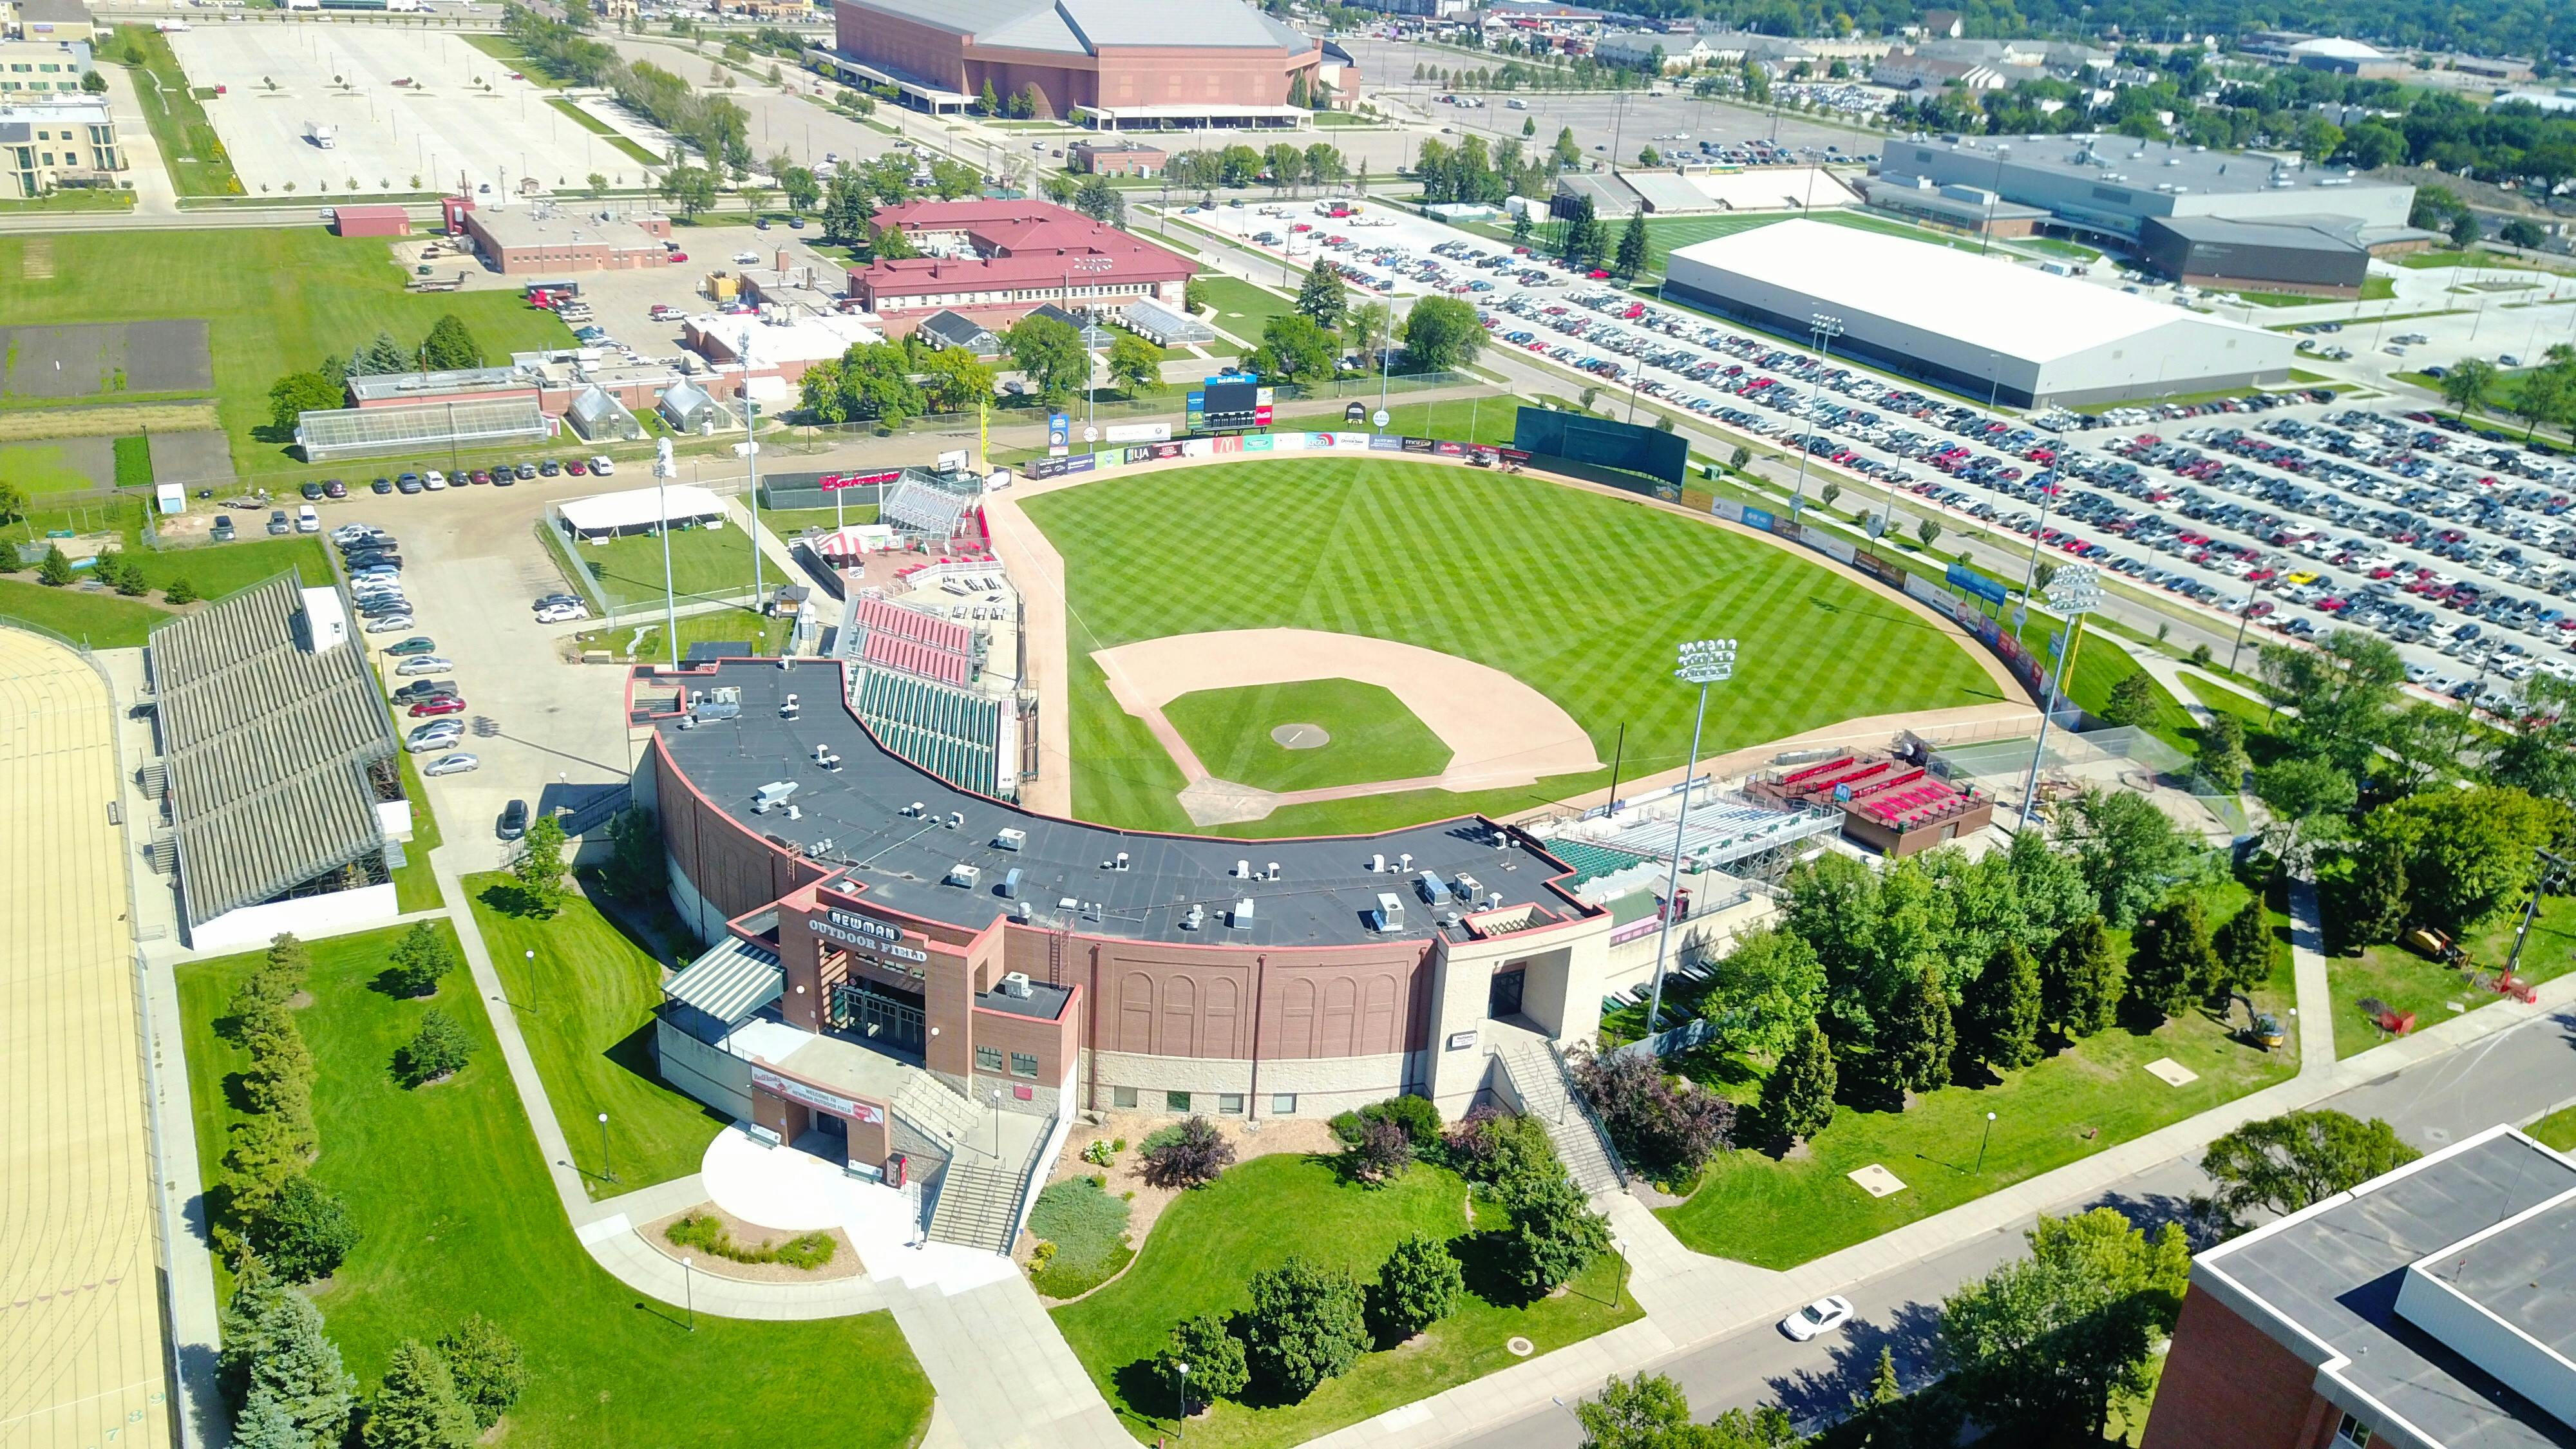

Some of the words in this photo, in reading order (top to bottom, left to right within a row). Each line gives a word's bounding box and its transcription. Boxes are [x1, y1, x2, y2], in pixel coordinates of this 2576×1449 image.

[1135, 448, 1150, 460] LJA
[832, 912, 895, 940] NEWMAN
[809, 920, 876, 951] OUTDOOR
[880, 942, 927, 962] FIELD
[792, 1090, 813, 1102] NEWMAN
[813, 1097, 837, 1110] OUTDOOR
[837, 1105, 851, 1113] FIELD
[805, 1089, 829, 1101] WELCOME
